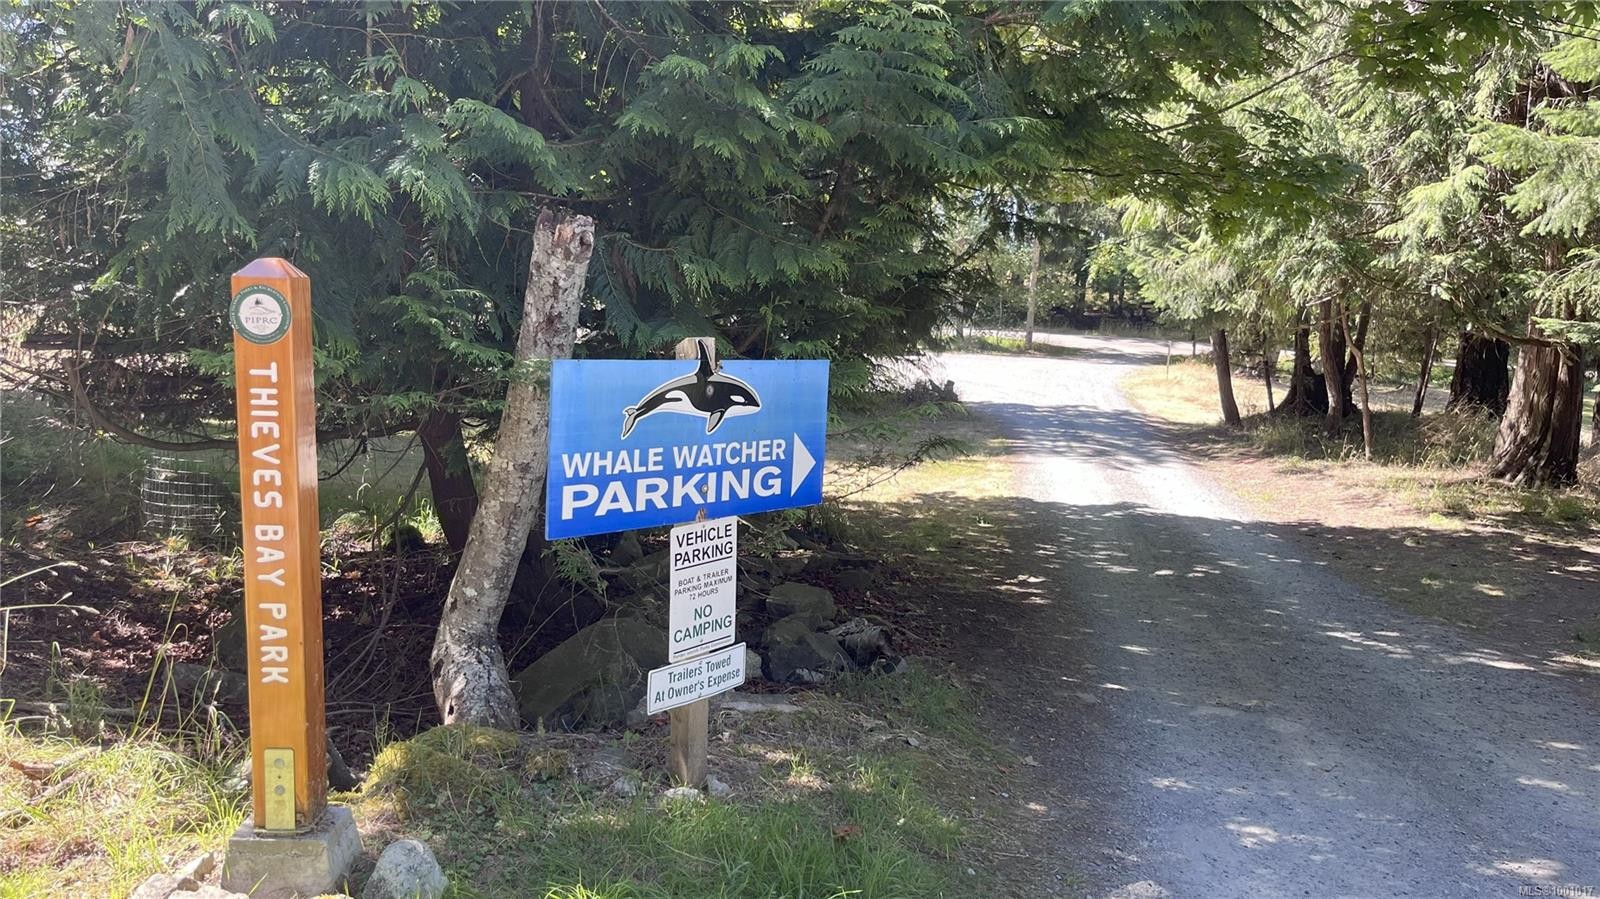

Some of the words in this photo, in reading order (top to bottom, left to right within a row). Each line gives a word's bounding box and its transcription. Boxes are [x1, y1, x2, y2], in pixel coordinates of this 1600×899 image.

[244, 316, 278, 325] PIPRC
[249, 361, 283, 508] THIEVES
[561, 447, 664, 479] WHALE
[672, 438, 786, 470] WATCHER
[560, 465, 782, 521] PARKING
[676, 523, 732, 548] VEHICLE
[254, 524, 286, 588] BAY
[674, 541, 733, 567] PARKING
[674, 583, 702, 596] PARKING
[703, 575, 733, 587] MAXIMUM
[678, 576, 695, 587] BOAT
[703, 568, 729, 580] TRAILER
[689, 593, 696, 601] 72
[697, 587, 719, 599] HOURS
[694, 604, 713, 621] NO
[258, 602, 289, 684] PARK
[673, 614, 732, 643] CAMPING
[667, 665, 703, 684] Trailers
[705, 654, 732, 673] Towed
[654, 690, 665, 704] At
[667, 679, 705, 700] Owner's
[707, 667, 741, 687] Expense
